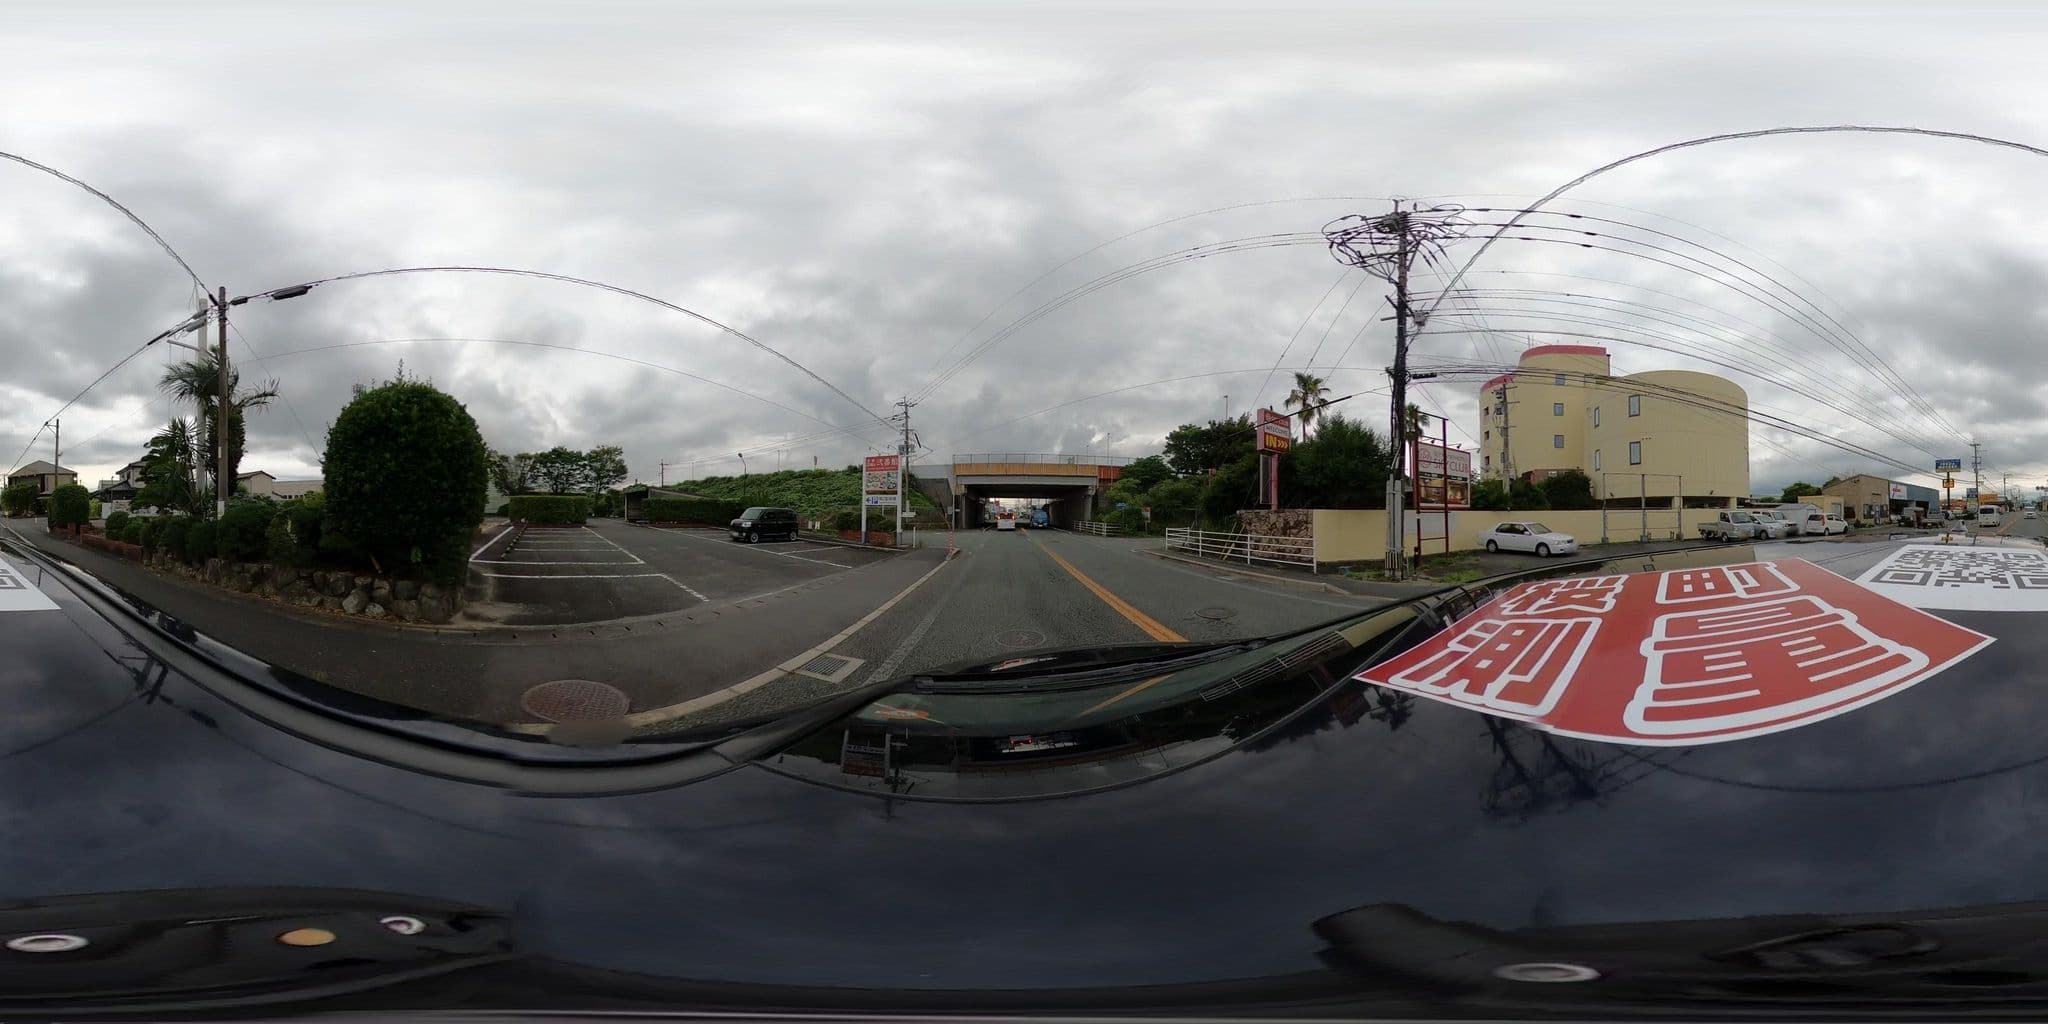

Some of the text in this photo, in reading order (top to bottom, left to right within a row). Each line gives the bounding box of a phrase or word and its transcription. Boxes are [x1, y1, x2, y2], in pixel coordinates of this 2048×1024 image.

[1266, 434, 1277, 447] IN
[1500, 561, 1800, 615] 桜町
[1388, 595, 1929, 735] 測量
